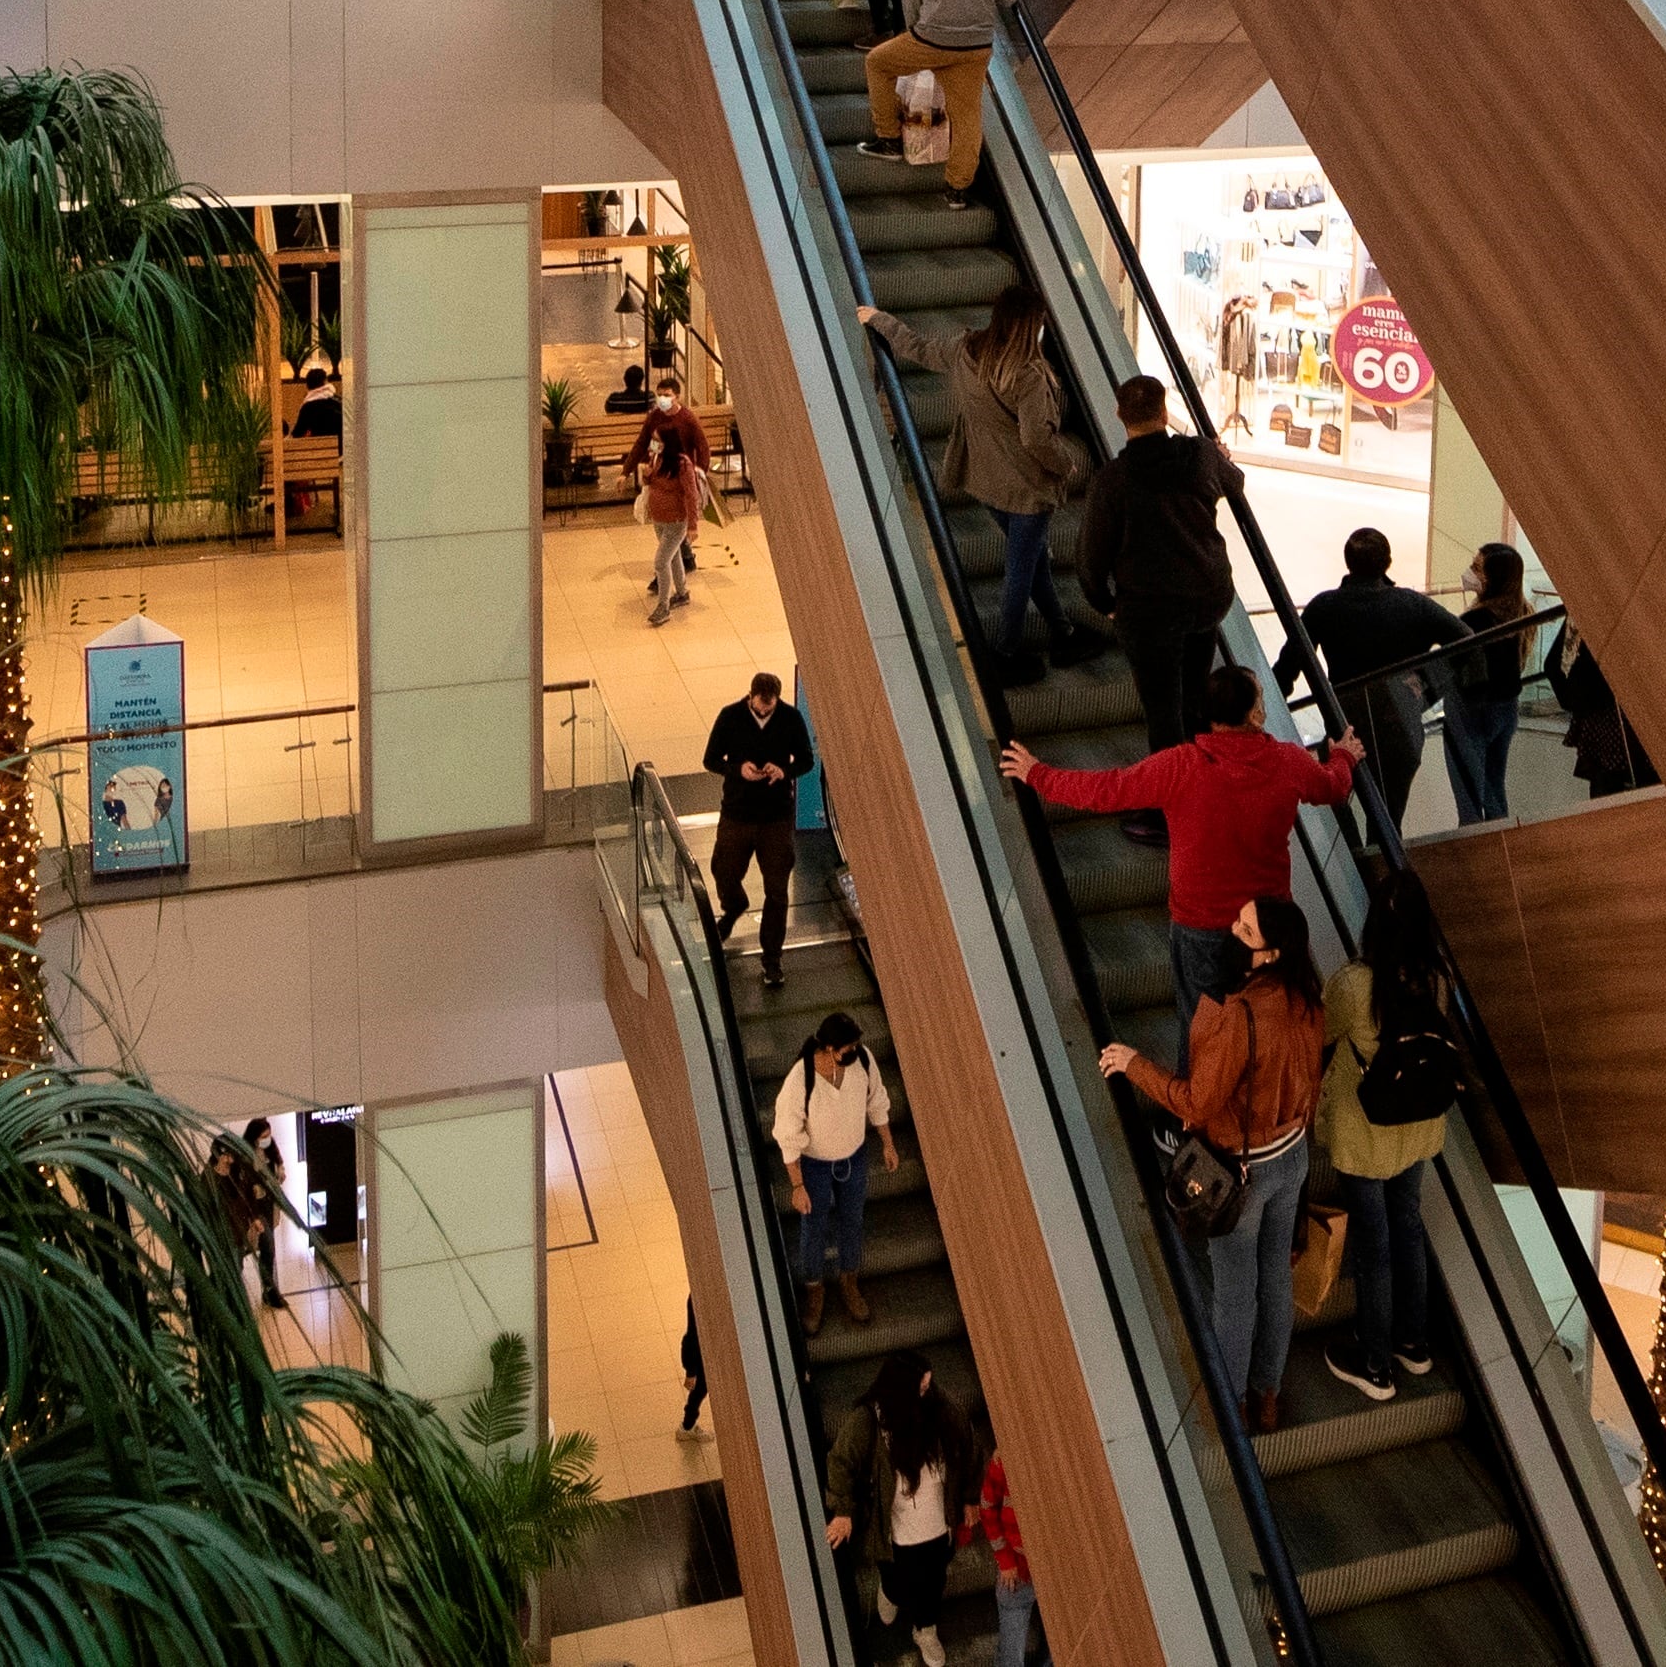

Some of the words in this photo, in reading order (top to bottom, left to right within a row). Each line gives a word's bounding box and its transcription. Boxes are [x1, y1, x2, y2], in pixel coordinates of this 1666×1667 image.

[1353, 347, 1420, 394] 60
[114, 696, 157, 708] MANTÉN
[110, 708, 162, 719] DISTANCIA
[127, 740, 177, 752] MOMENTO
